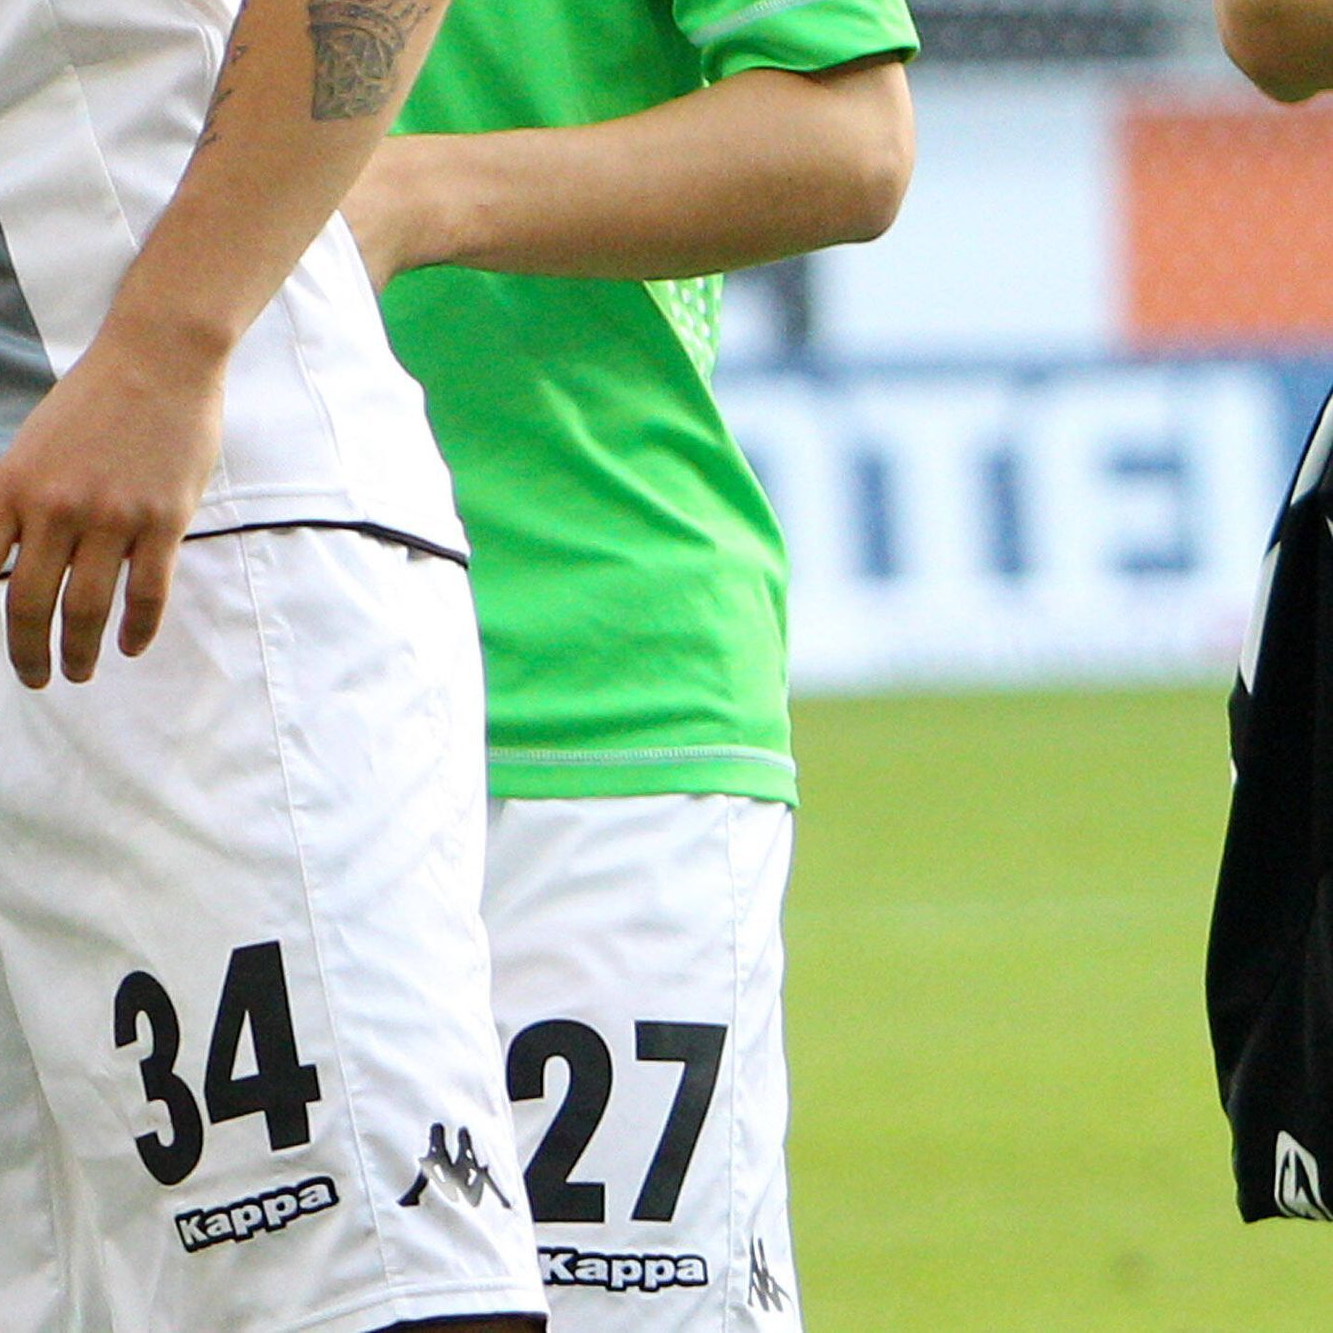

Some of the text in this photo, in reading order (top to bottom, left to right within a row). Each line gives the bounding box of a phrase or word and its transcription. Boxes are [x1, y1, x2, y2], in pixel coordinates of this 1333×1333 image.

[114, 940, 321, 1186] 34
[505, 1019, 729, 1224] 27
[179, 1183, 332, 1245] Kappa
[539, 1253, 705, 1289] Kappa
